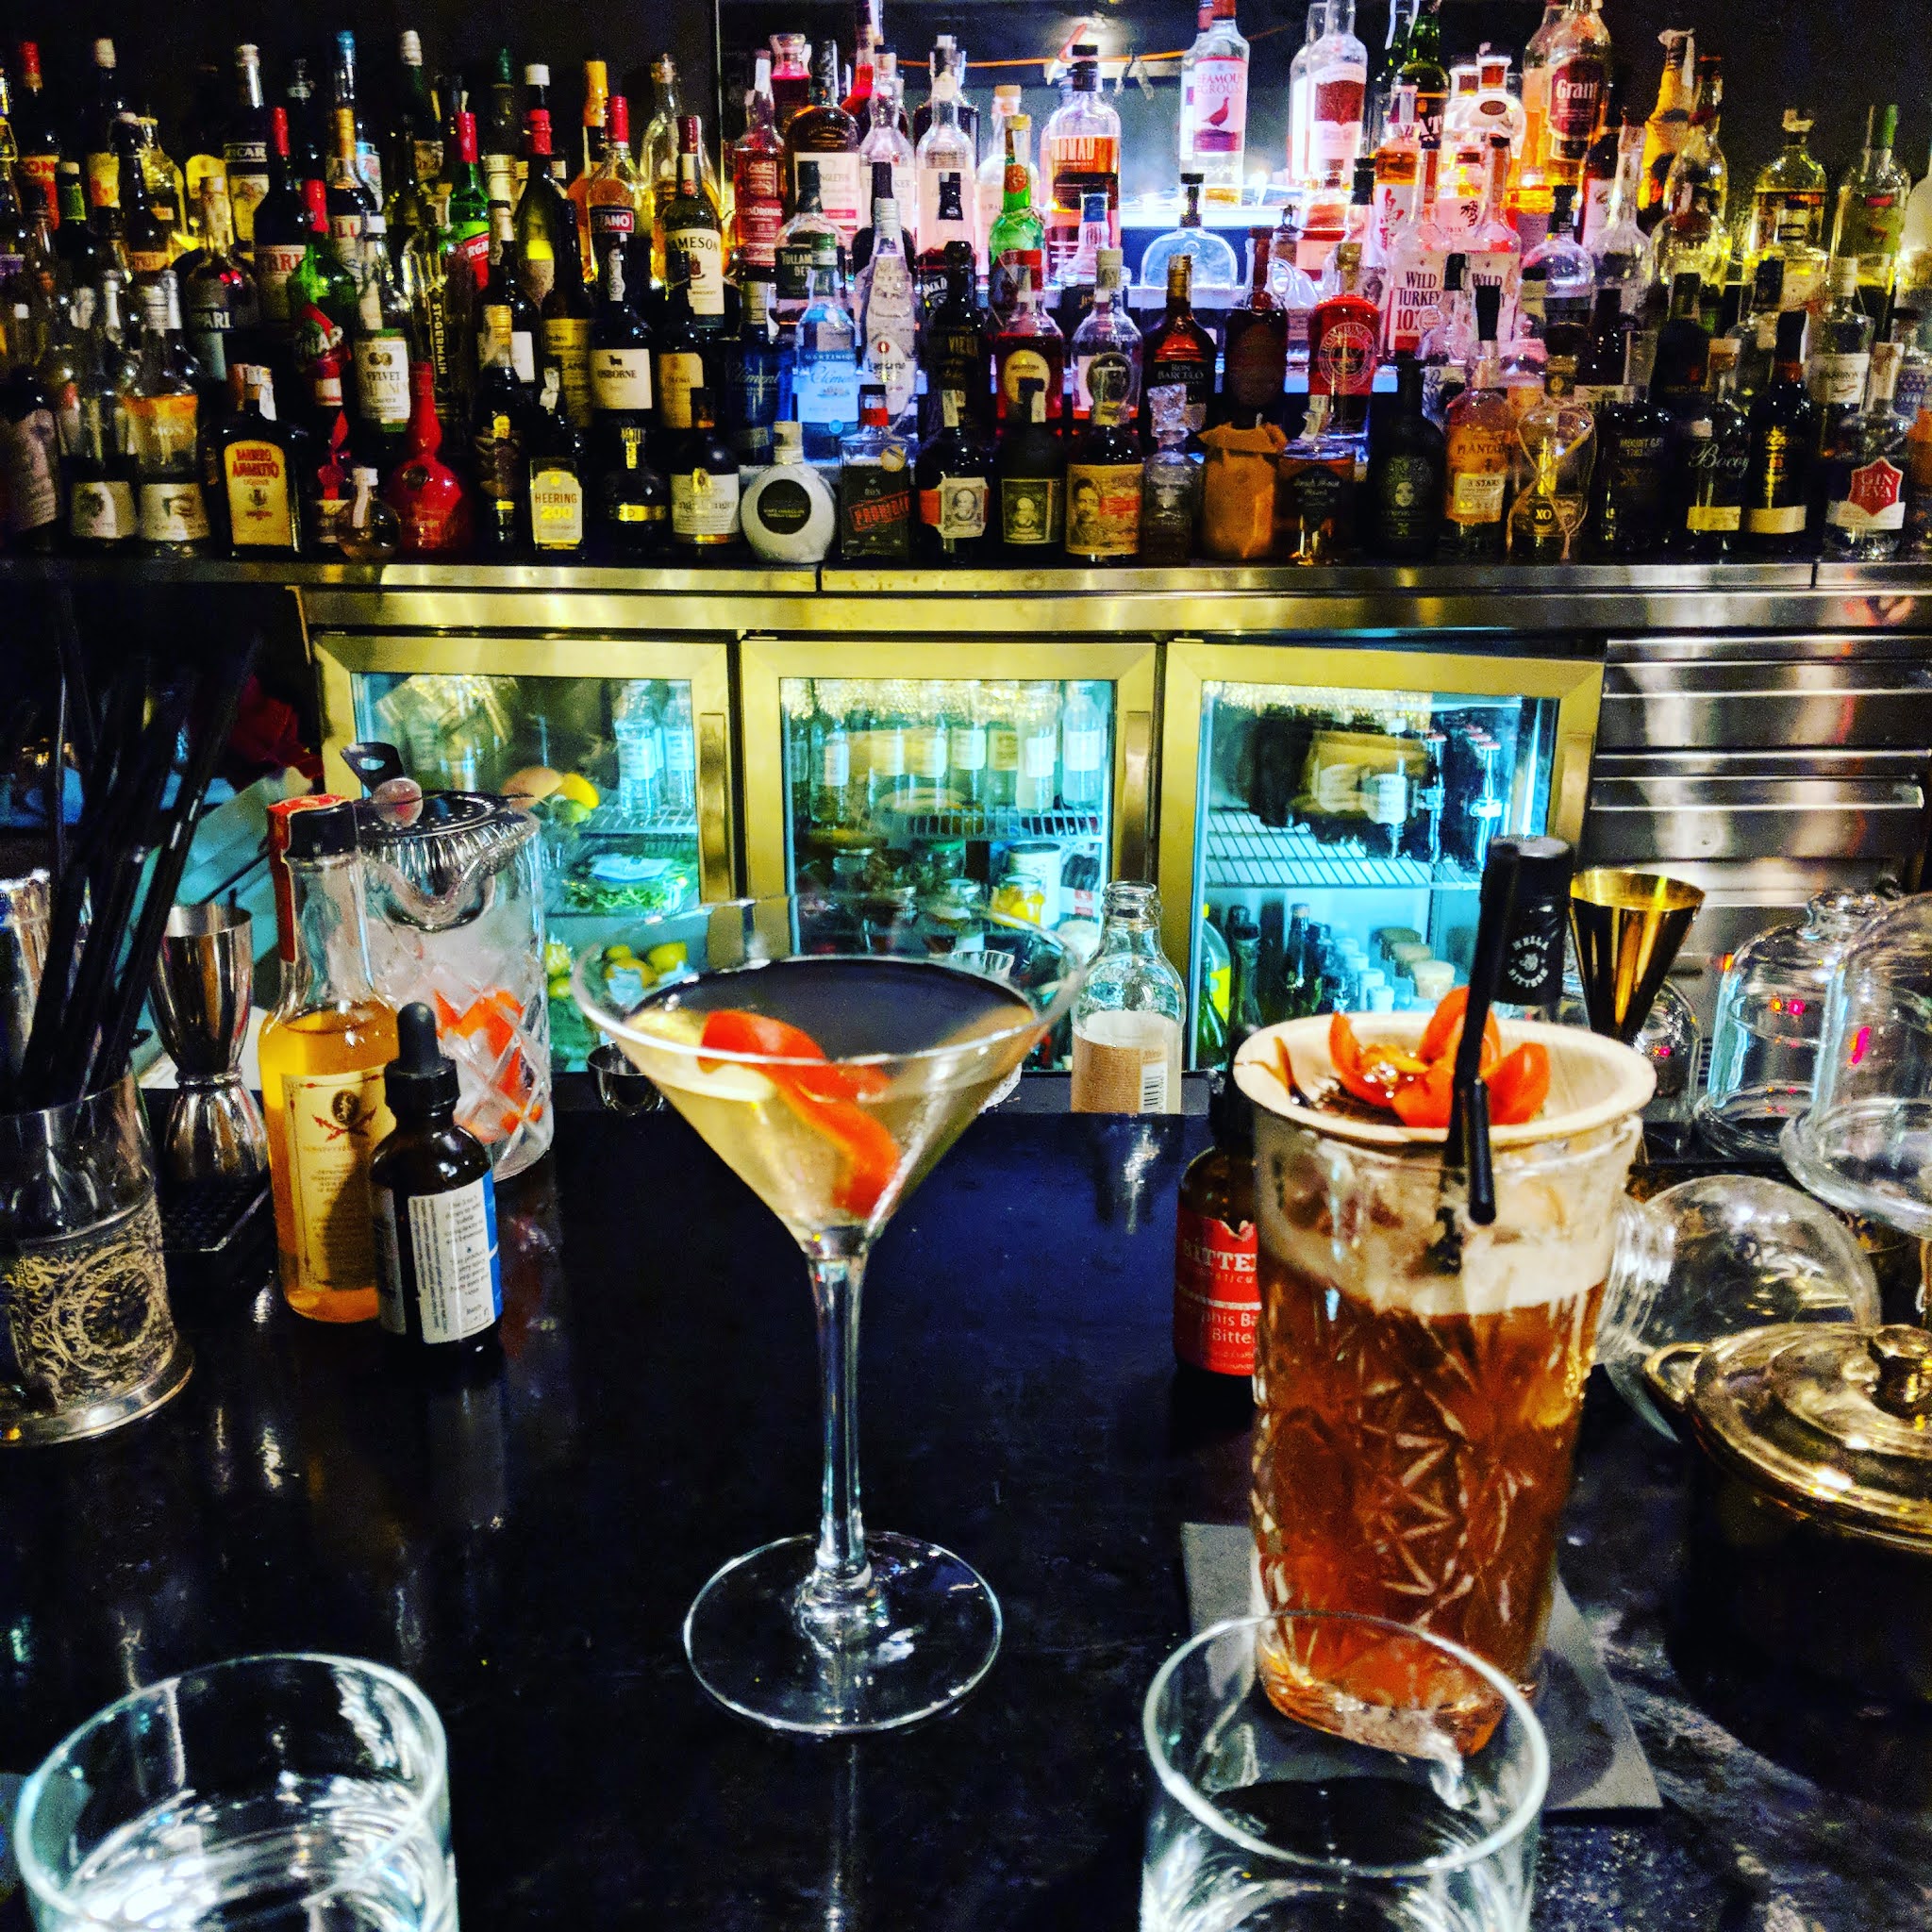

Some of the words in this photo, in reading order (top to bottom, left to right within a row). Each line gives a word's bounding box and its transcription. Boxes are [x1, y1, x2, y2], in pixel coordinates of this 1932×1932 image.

[1407, 271, 1437, 289] WILD
[1396, 288, 1442, 306] TURKEY
[1860, 473, 1894, 486] GIN
[535, 492, 577, 504] HEERING
[1535, 509, 1552, 520] XO
